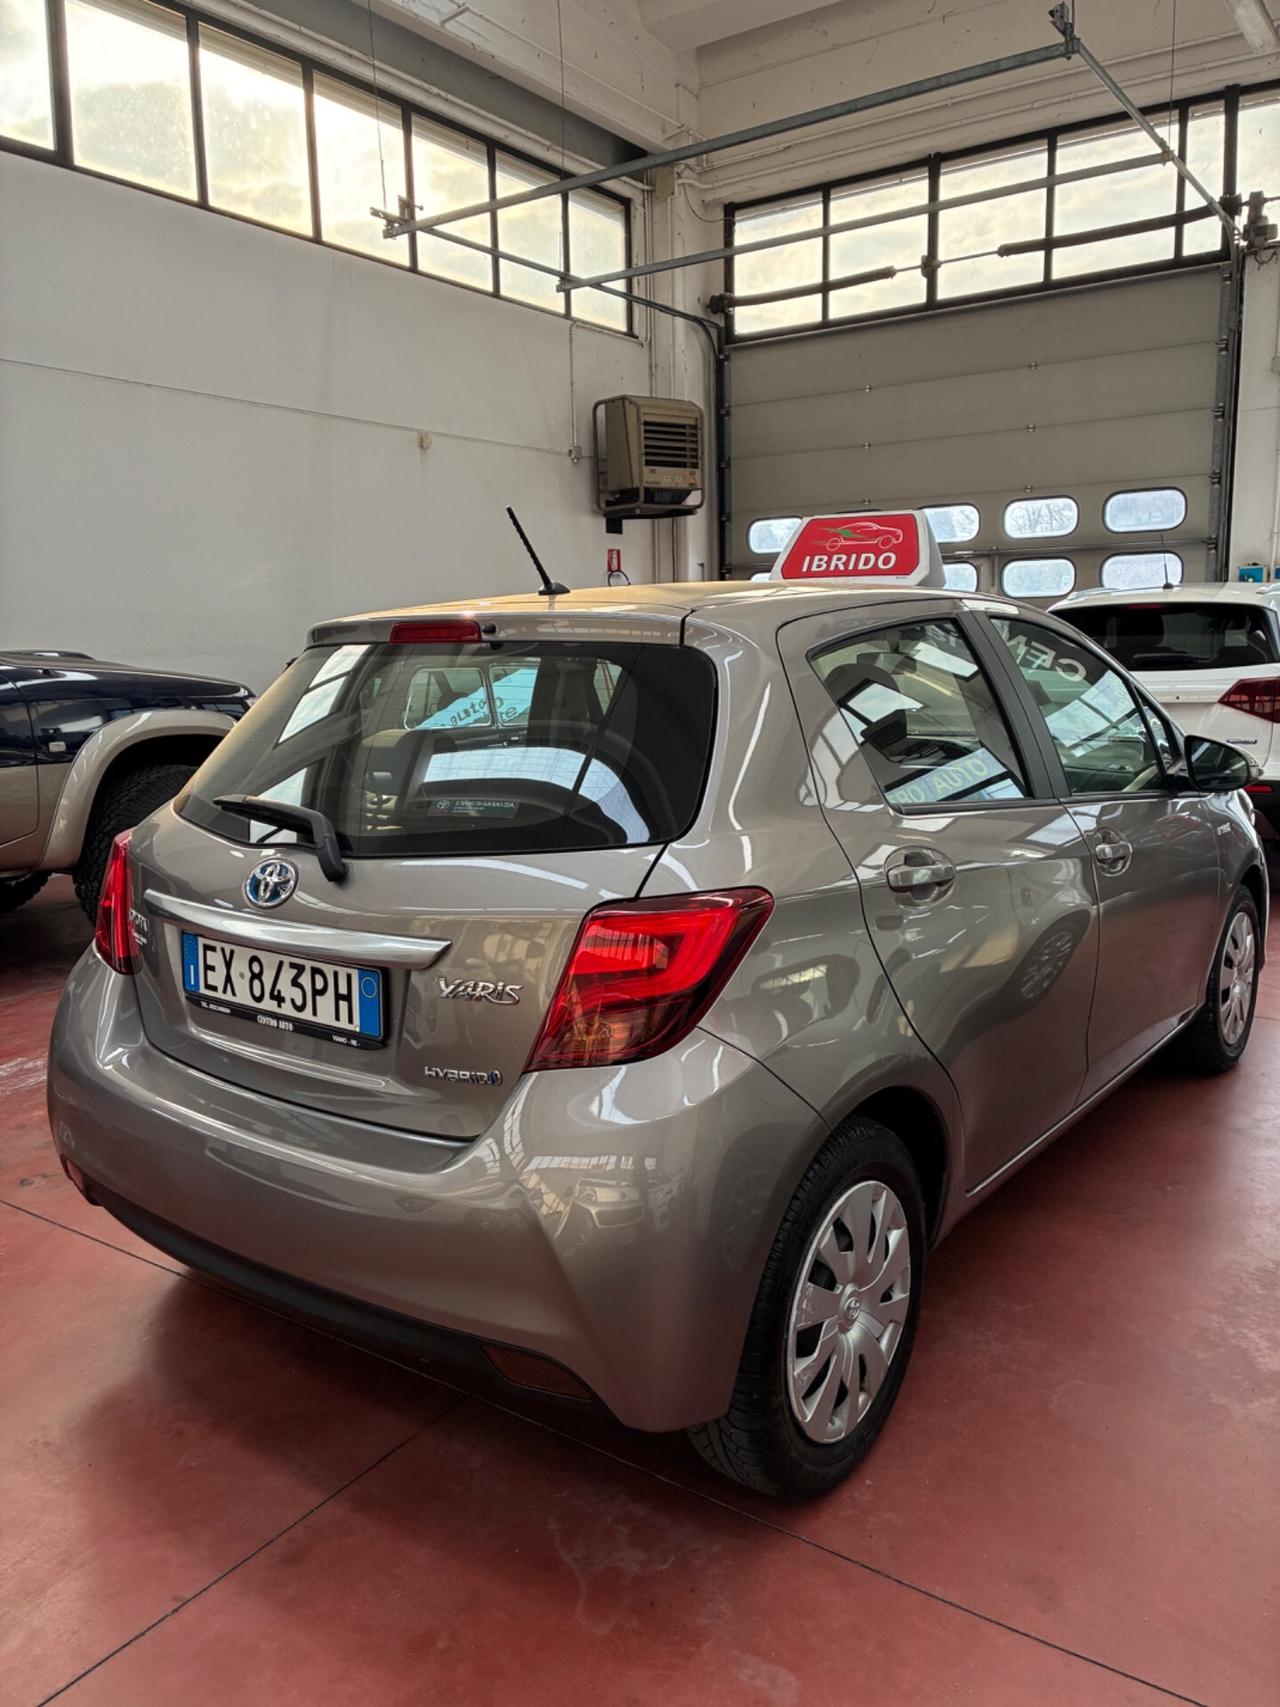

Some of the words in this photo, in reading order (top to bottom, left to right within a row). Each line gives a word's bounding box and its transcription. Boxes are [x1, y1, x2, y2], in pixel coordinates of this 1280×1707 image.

[802, 552, 897, 573] IBRIDO
[932, 757, 988, 795] AUTO
[424, 1066, 488, 1085] HYBRID
